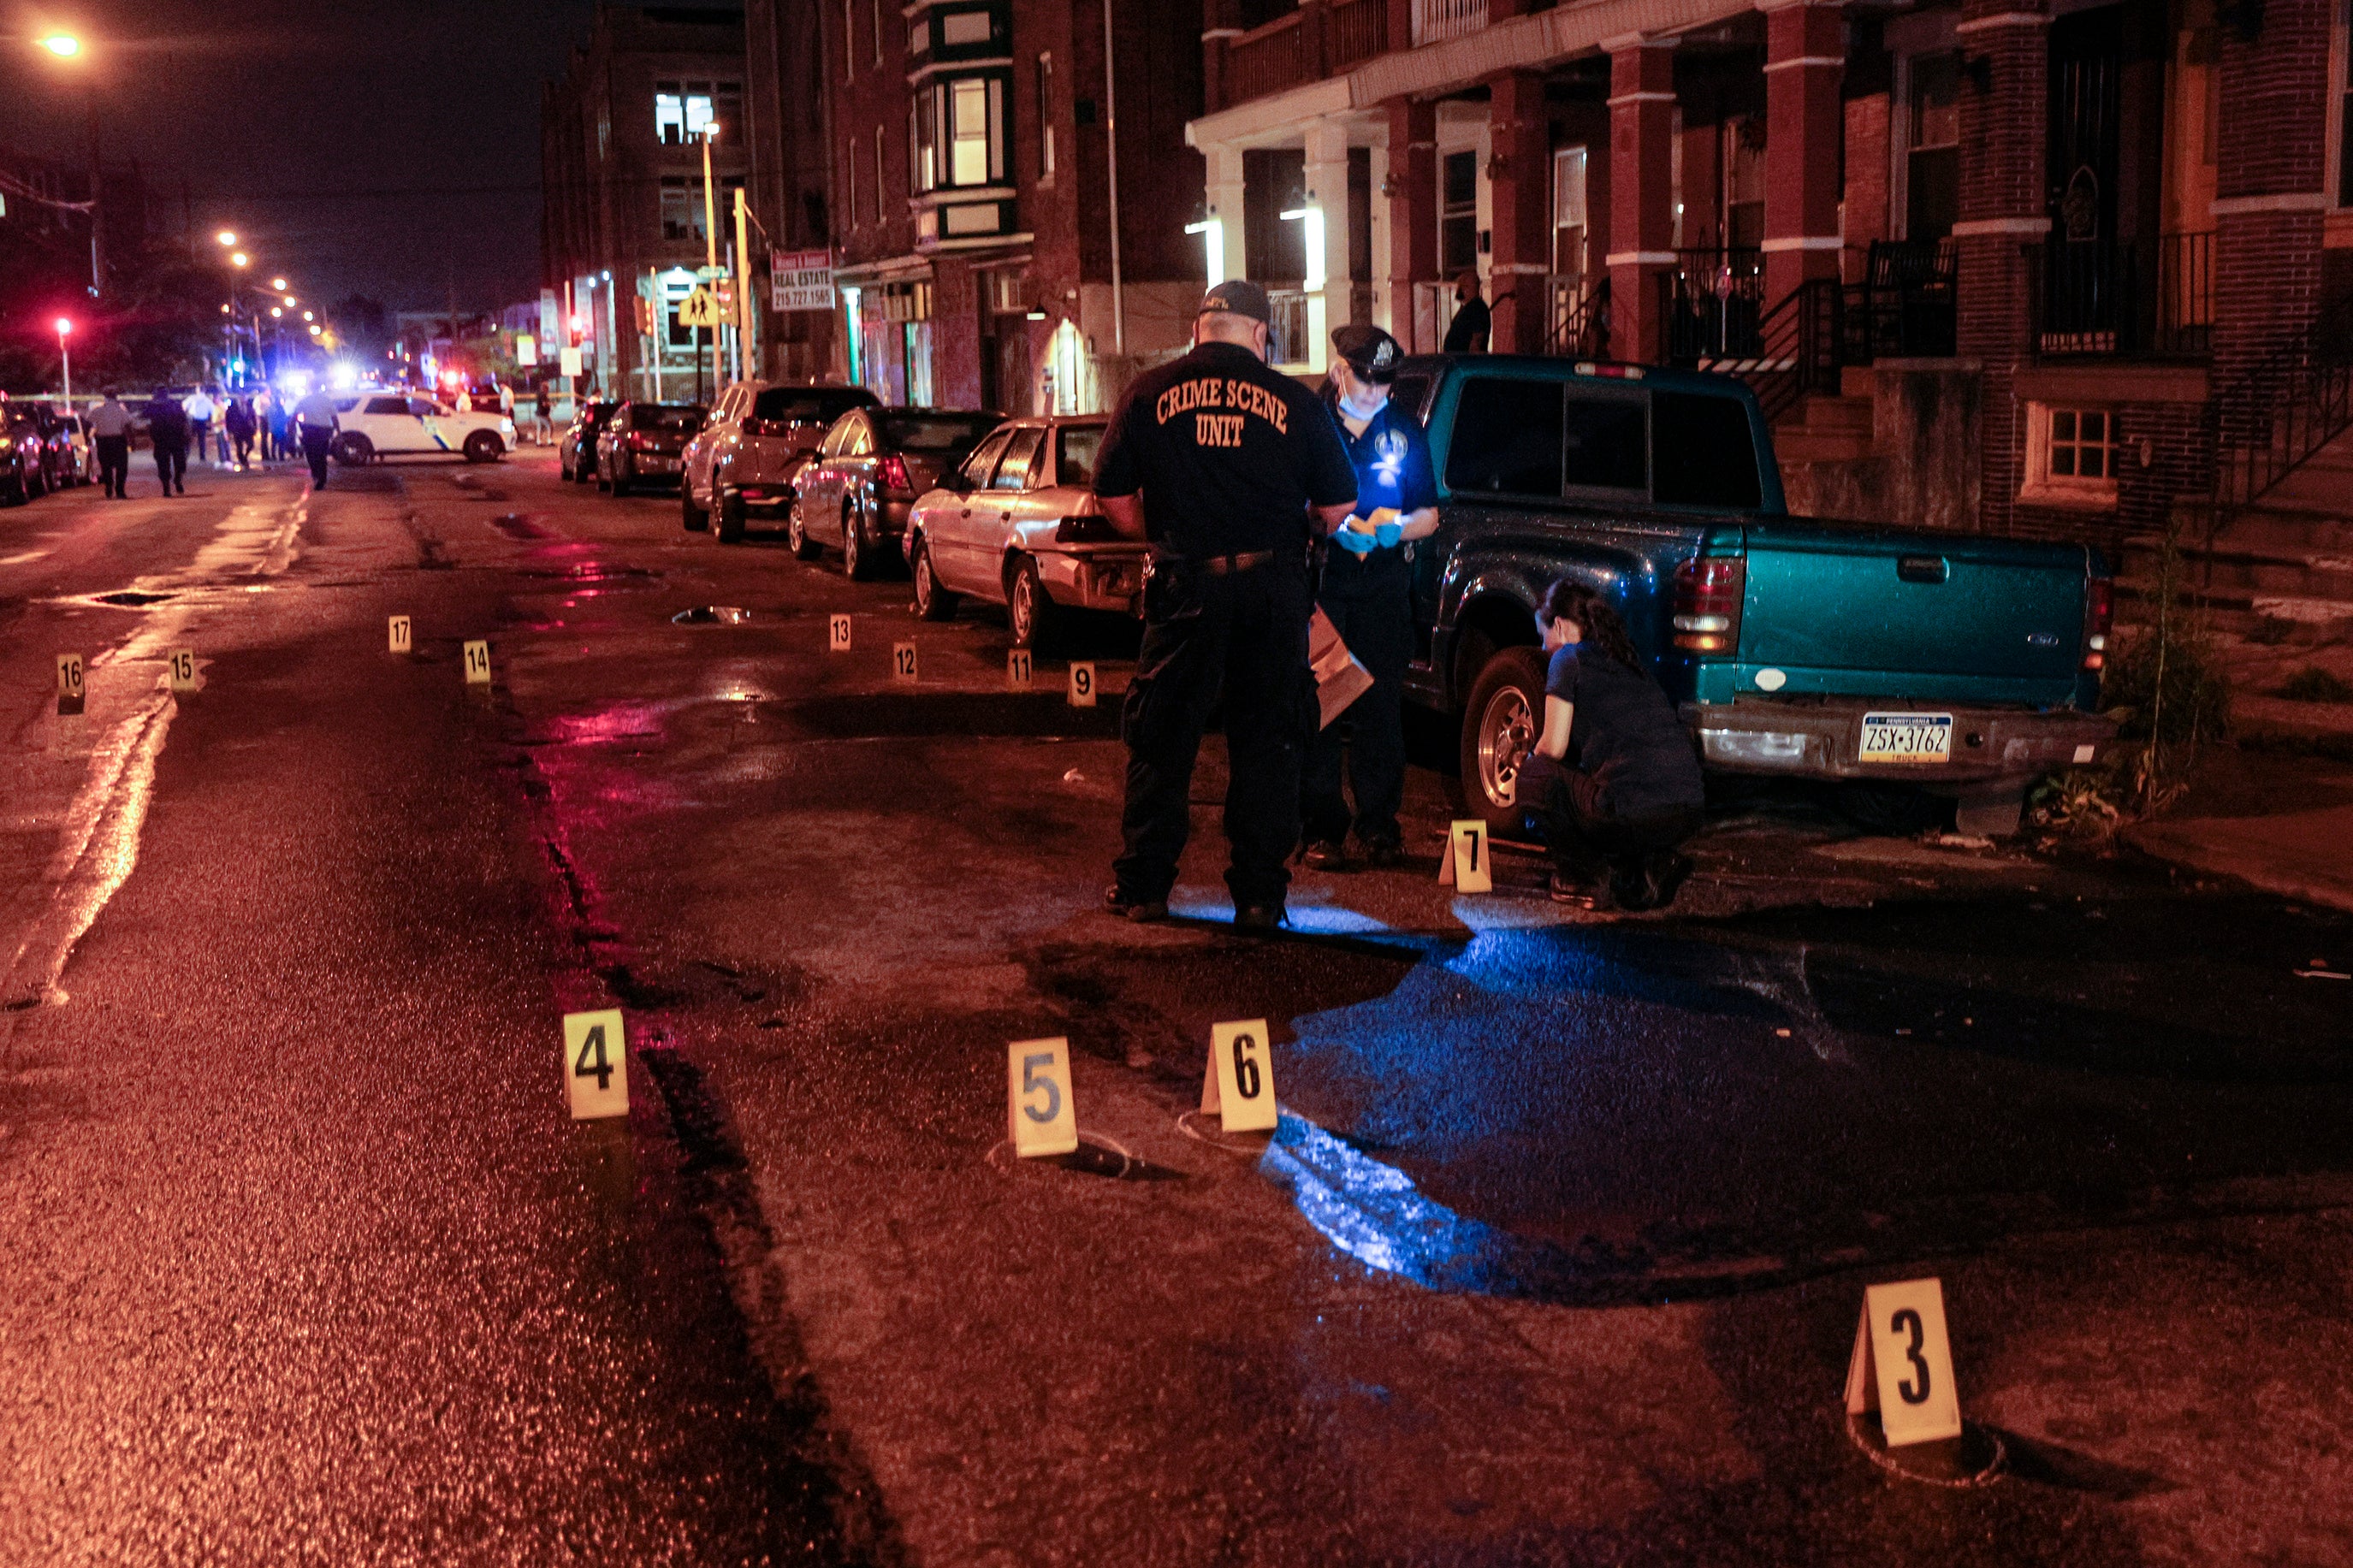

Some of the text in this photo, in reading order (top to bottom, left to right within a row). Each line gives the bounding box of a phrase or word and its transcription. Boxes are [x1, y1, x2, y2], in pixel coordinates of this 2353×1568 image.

[774, 269, 830, 287] REAL ESTATE
[1157, 377, 1288, 435] CRIME SCENE
[1195, 412, 1245, 447] UNIT
[394, 620, 408, 644] 17
[833, 619, 848, 643] 13
[61, 660, 82, 688] 16
[171, 654, 192, 682] 15
[466, 647, 487, 673] 14
[896, 648, 916, 674] 12
[1011, 654, 1029, 681] 11
[1075, 668, 1091, 695] 9
[1462, 829, 1479, 873] 7
[574, 1023, 614, 1091] 4
[1232, 1033, 1261, 1100] 6
[1022, 1051, 1062, 1125] 5
[1890, 1308, 1931, 1406] 3
